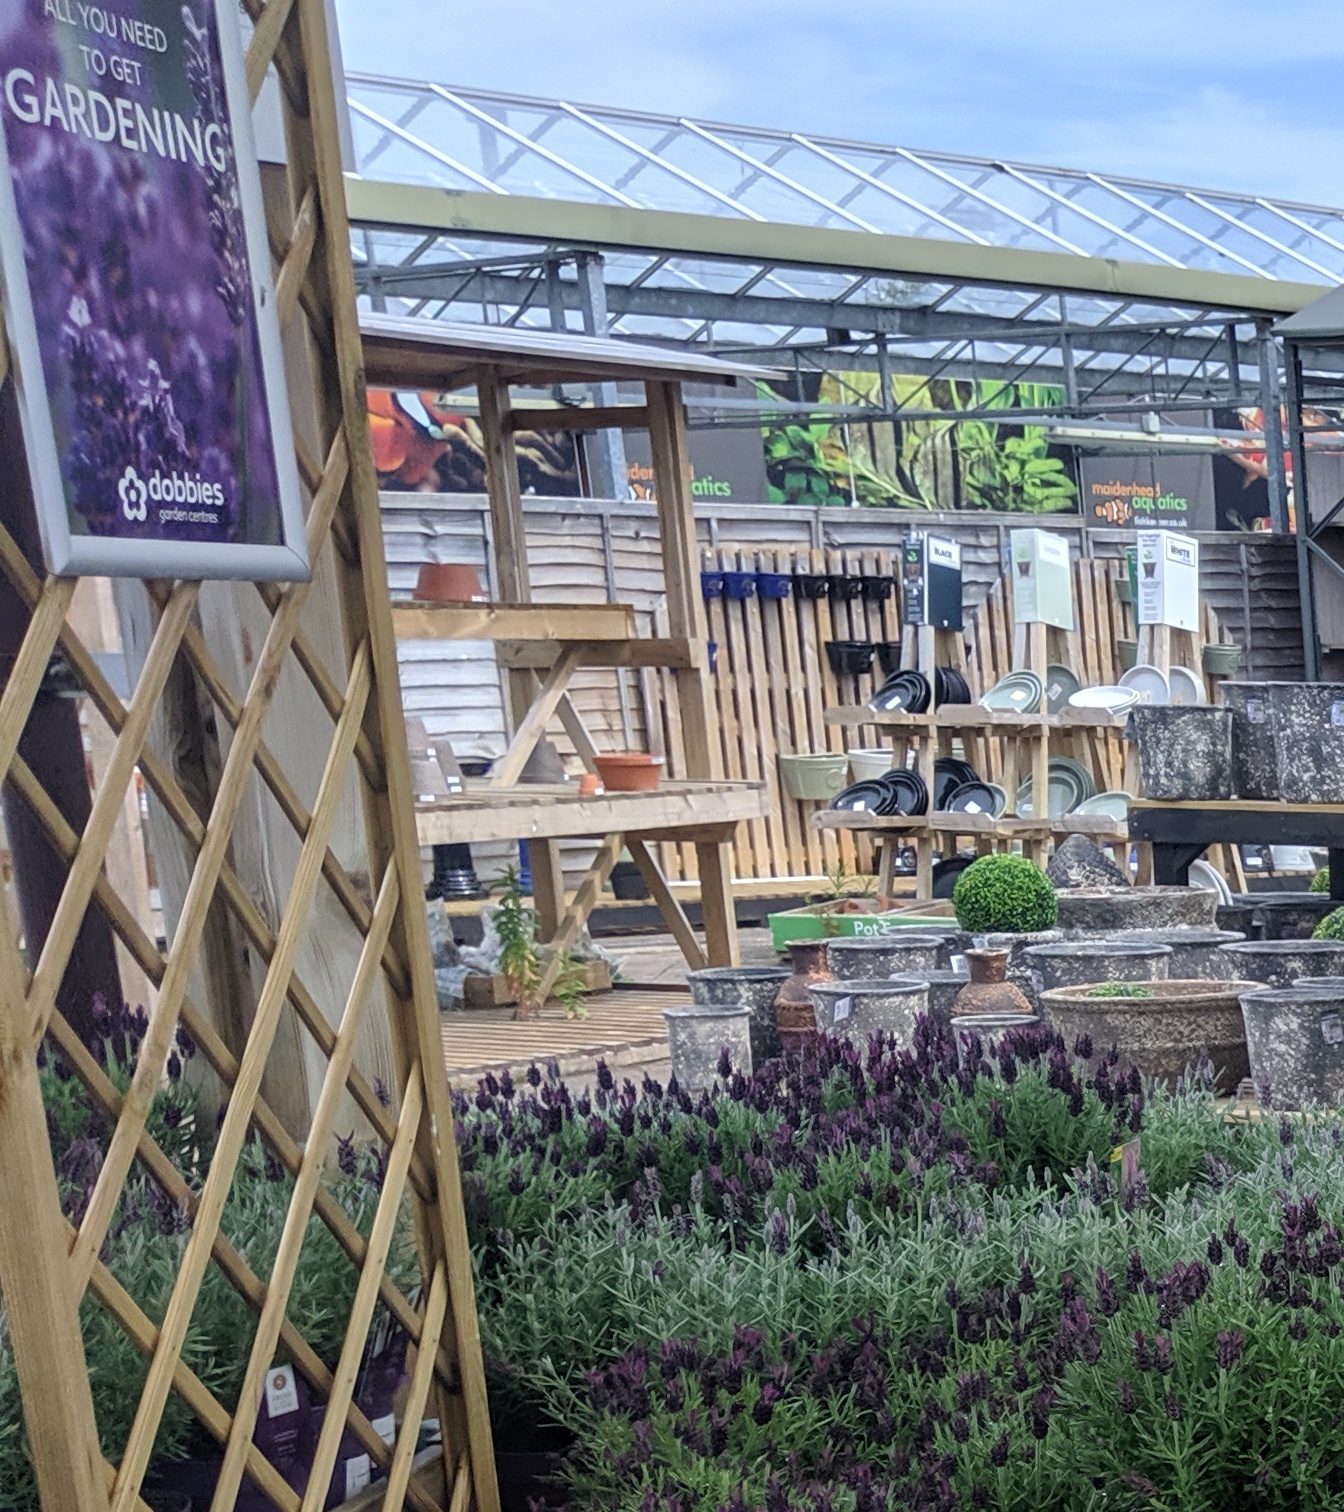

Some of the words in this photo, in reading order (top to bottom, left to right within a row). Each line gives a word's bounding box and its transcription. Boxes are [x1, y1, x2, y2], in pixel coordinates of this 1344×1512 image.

[44, 0, 77, 26] ALL
[78, 1, 118, 38] YOU
[120, 16, 168, 53] NEED
[79, 45, 107, 76] TO
[109, 55, 142, 86] GET
[4, 67, 227, 173] GARDENING
[148, 468, 226, 507] dobbies
[1131, 491, 1188, 515] aquatics
